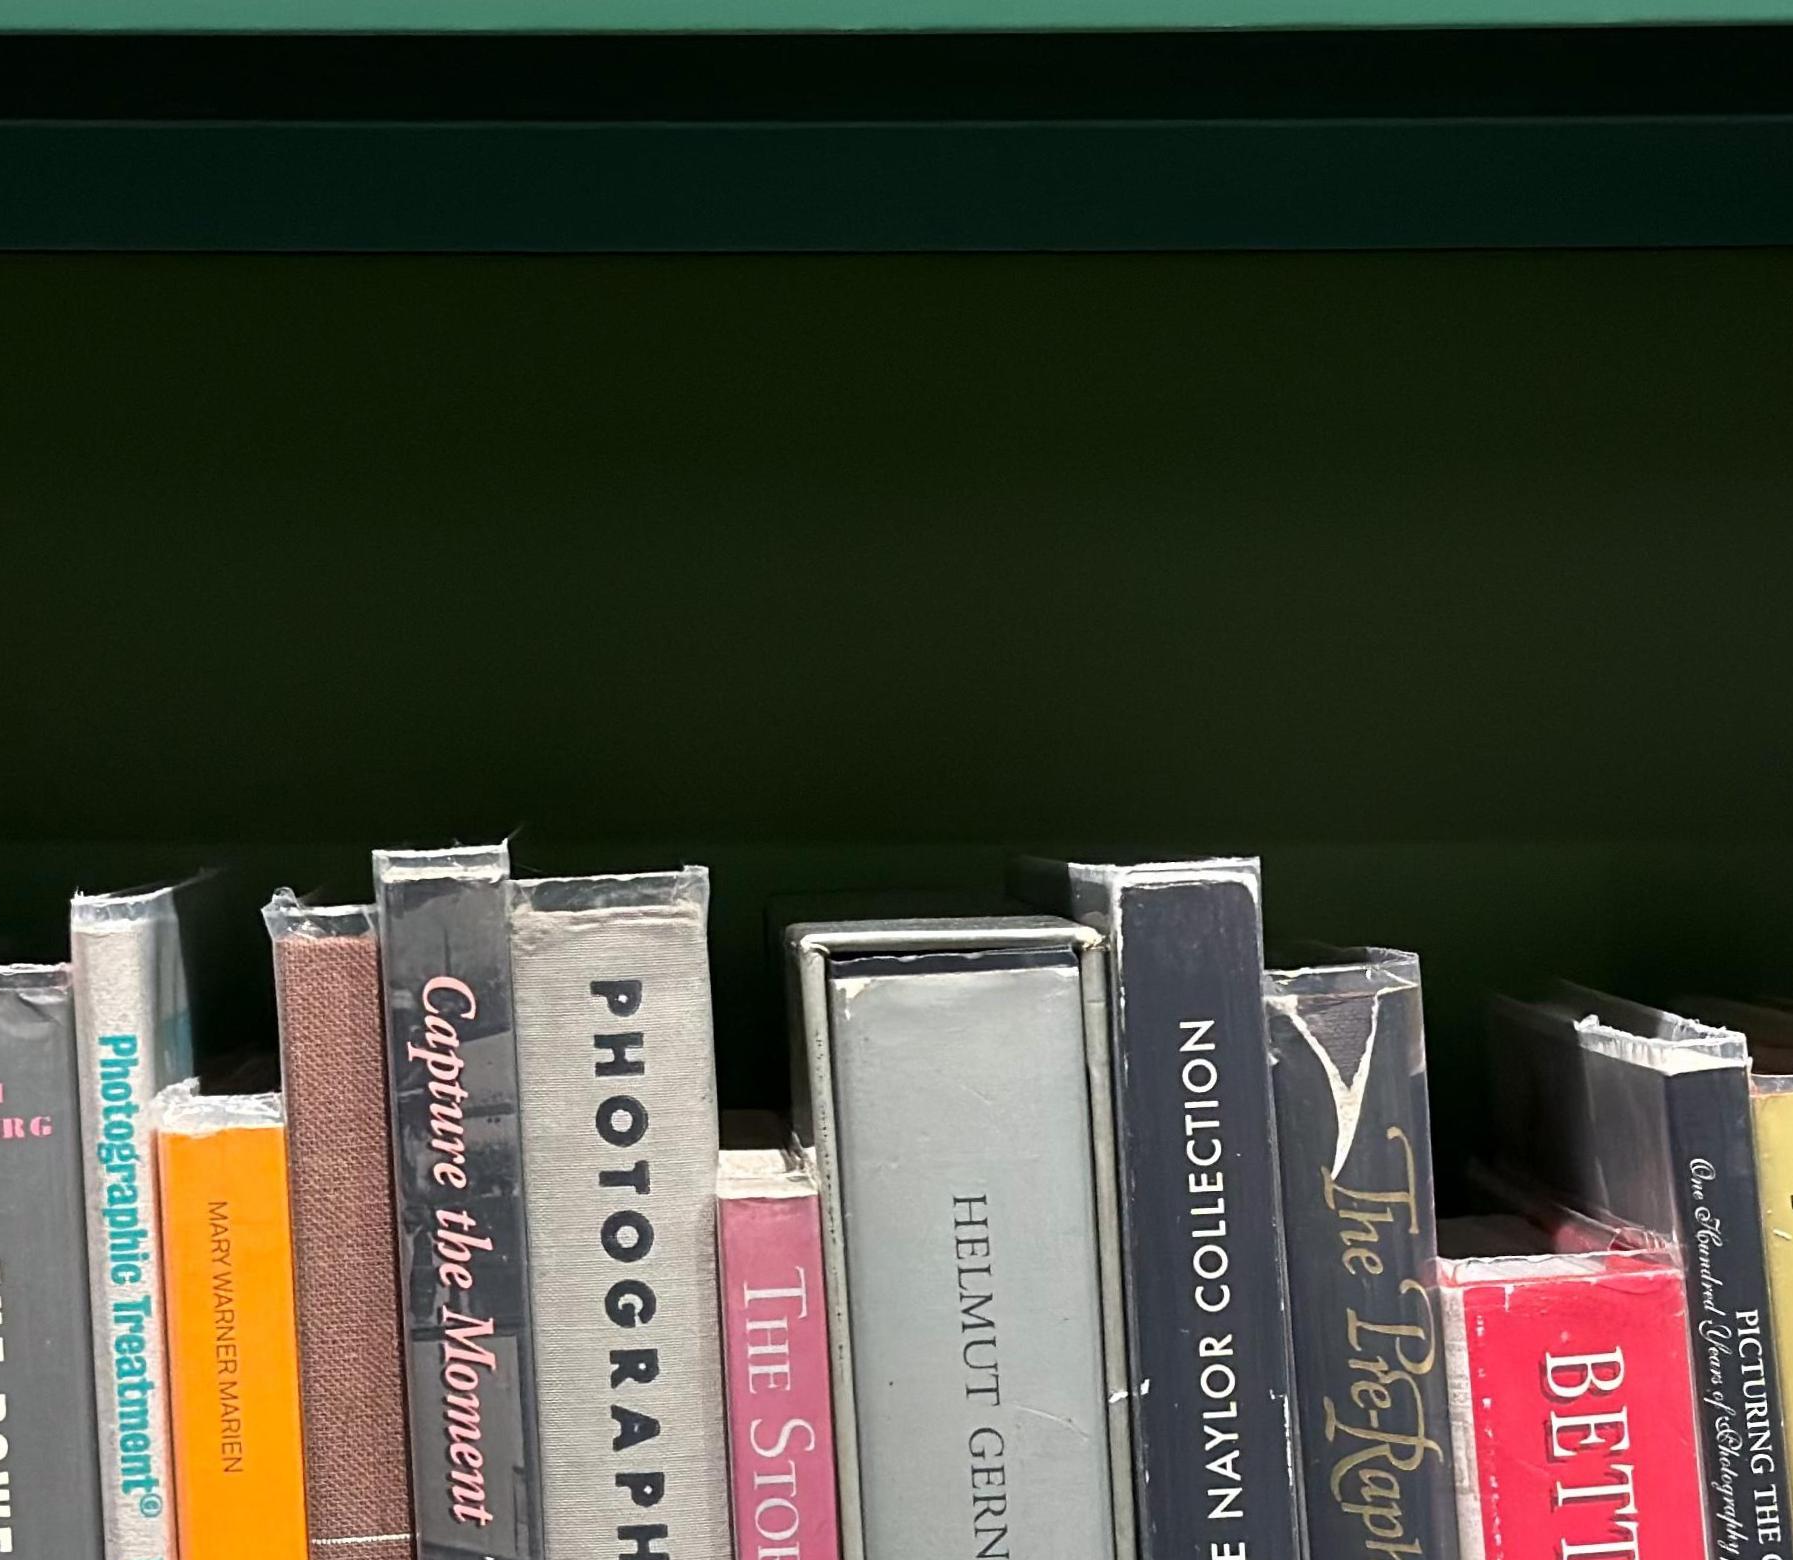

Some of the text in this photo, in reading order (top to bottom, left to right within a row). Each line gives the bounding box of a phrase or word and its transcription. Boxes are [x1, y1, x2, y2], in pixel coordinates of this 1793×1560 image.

[407, 975, 498, 1528] Capture the Moment
[1179, 1019, 1233, 1312] COLLECTION
[1323, 1126, 1419, 1276] The
[208, 1200, 245, 1474] MARY WARNER MARIEN
[951, 1194, 1000, 1406] HELMUT
[1734, 1308, 1775, 1473] PICTURING
[1199, 1332, 1246, 1519] NAYLOR
[1753, 1483, 1783, 1545] THE
